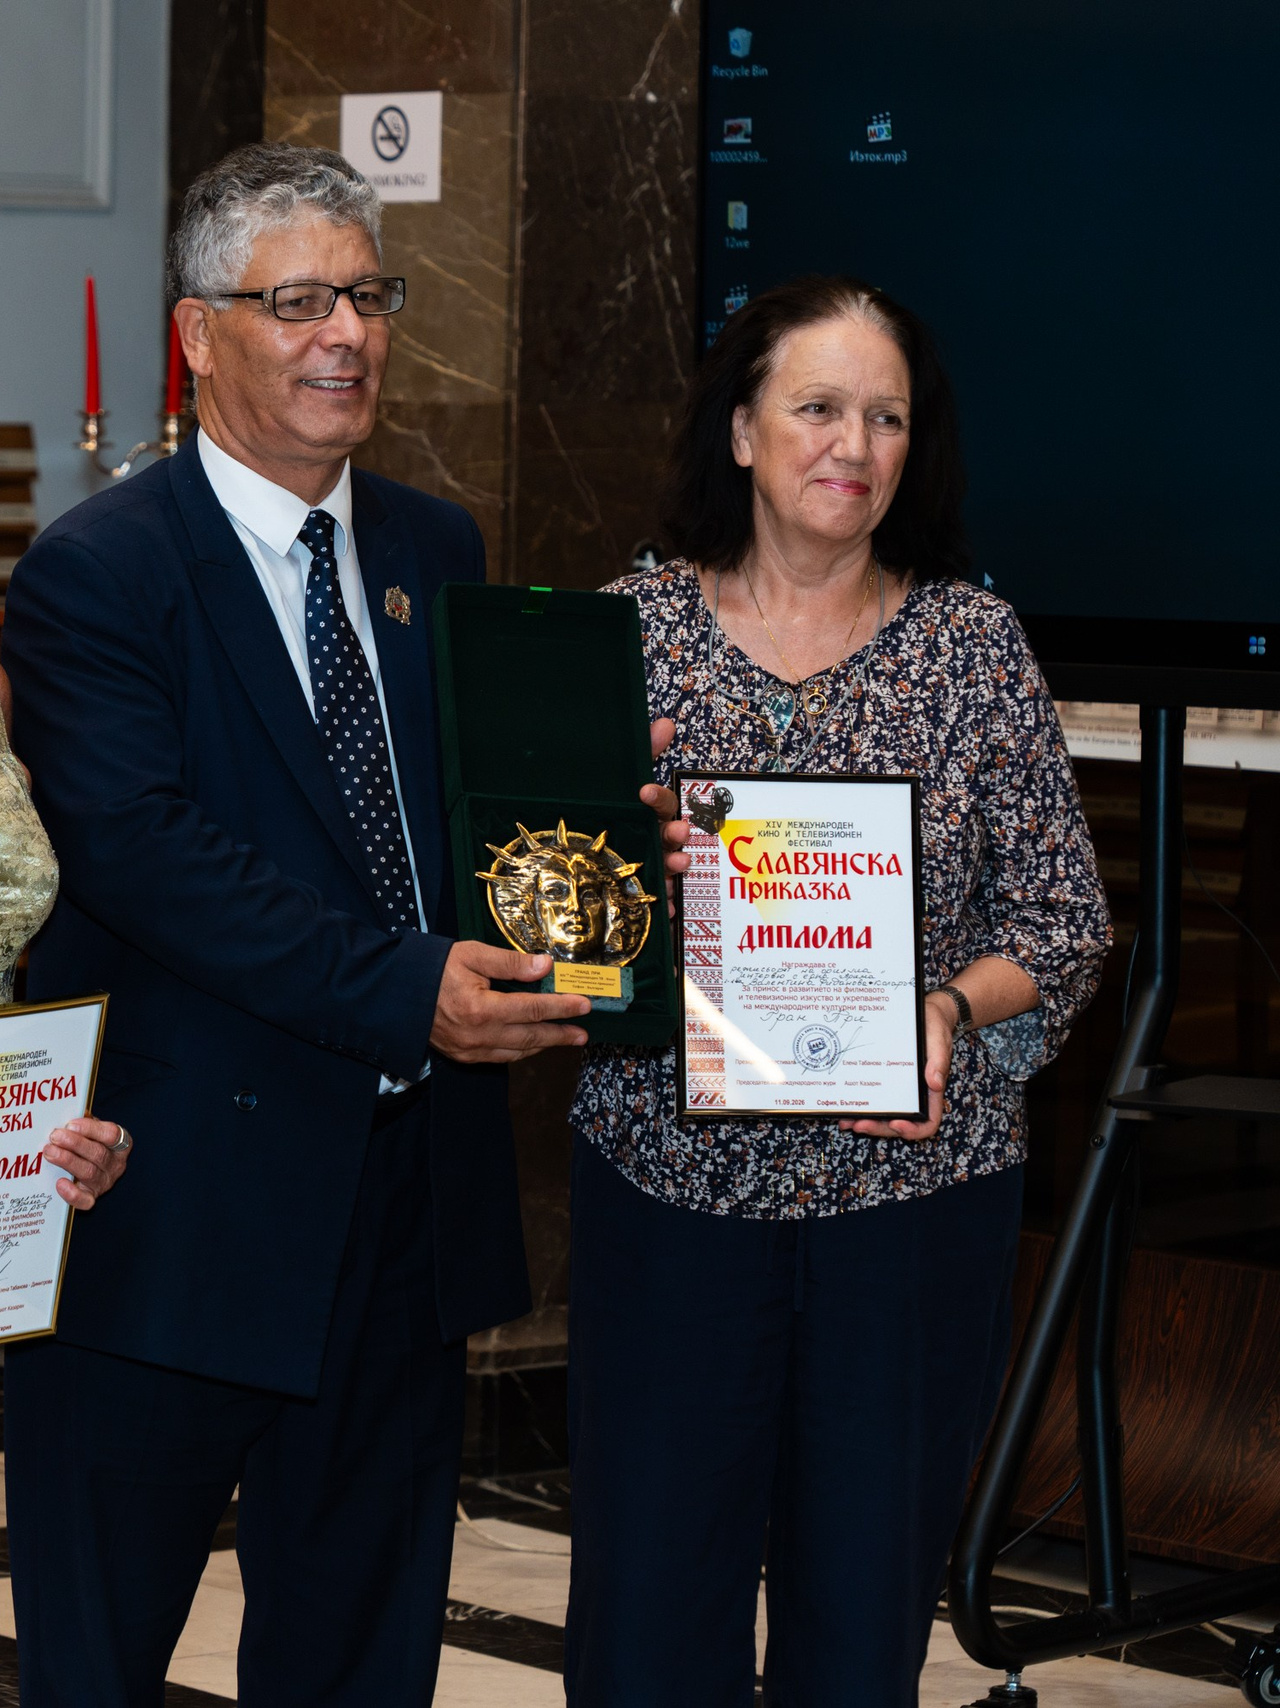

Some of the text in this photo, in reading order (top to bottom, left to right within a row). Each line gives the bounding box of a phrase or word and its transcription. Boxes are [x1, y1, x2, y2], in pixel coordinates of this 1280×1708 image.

[752, 64, 768, 77] Bin
[787, 821, 853, 829] МЕЖДУНАРОДЕН
[796, 830, 862, 838] ТЕЛЕВИЗИОНЕН
[787, 839, 832, 847] ФЕСТИВАЛ
[1, 1058, 52, 1072] ТЕЛЕВИЗИОНЕН
